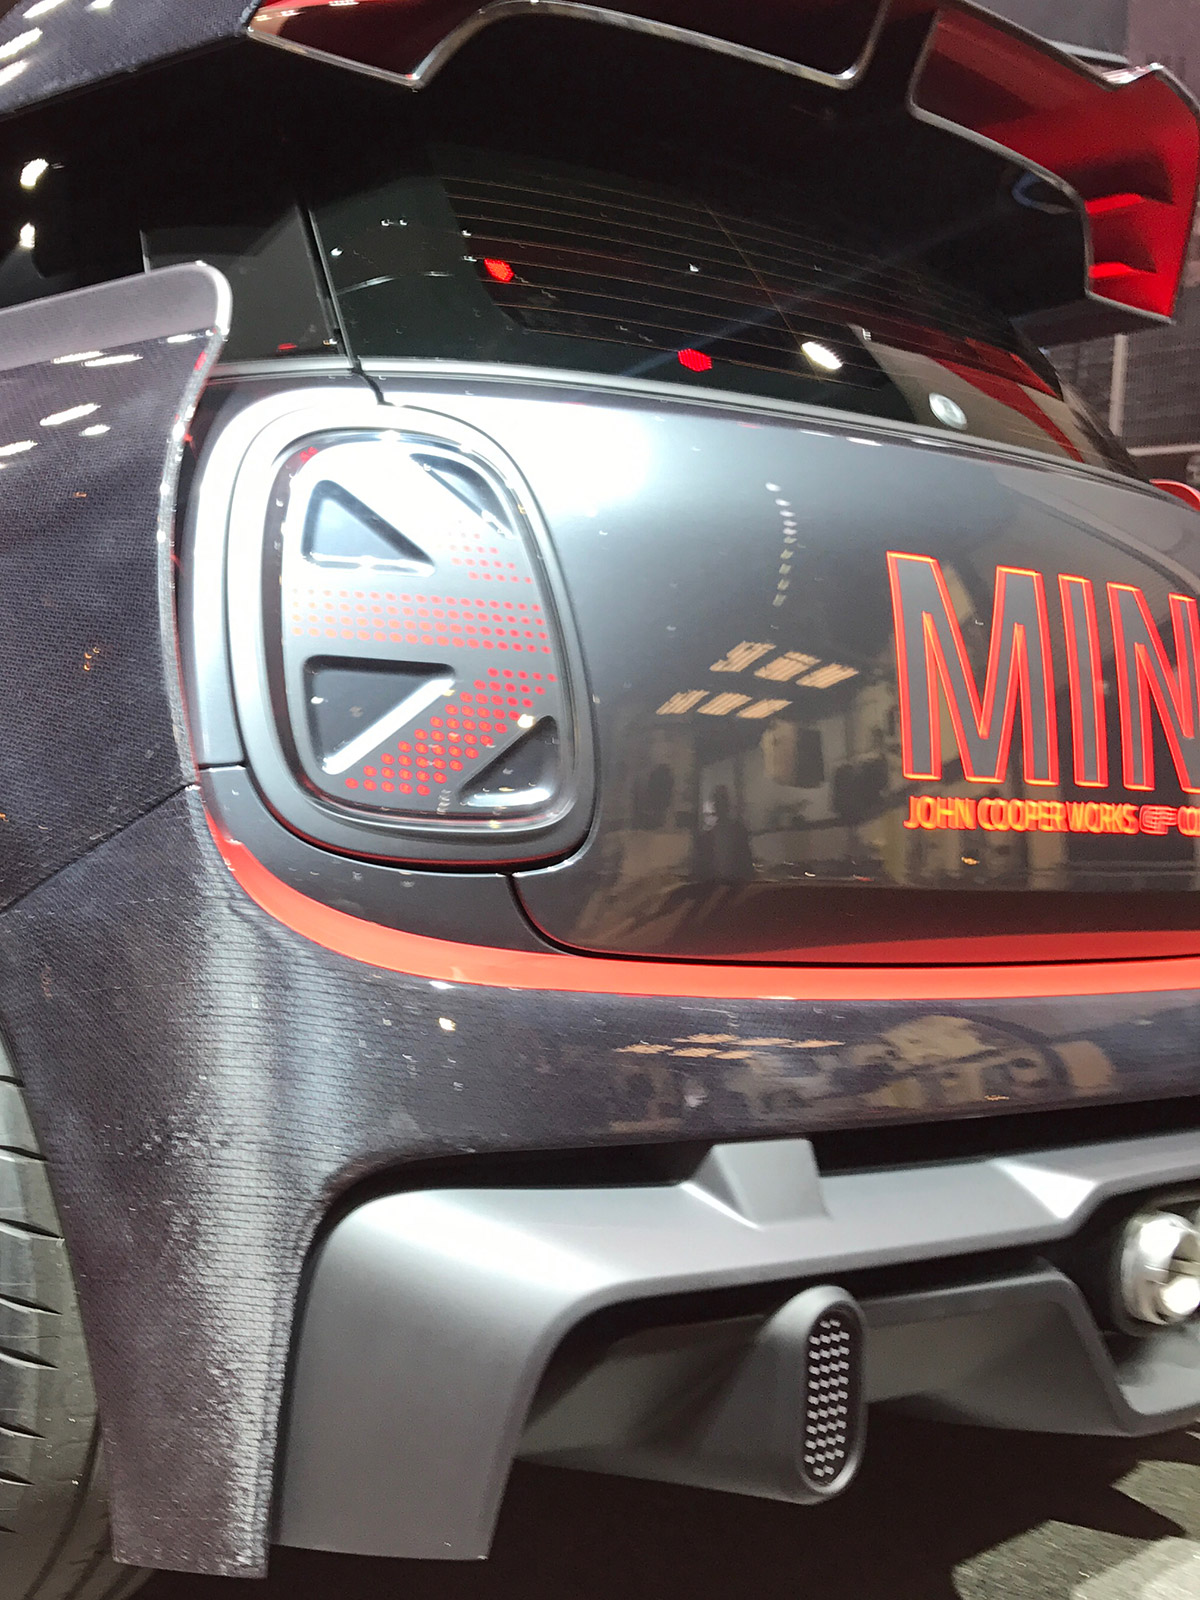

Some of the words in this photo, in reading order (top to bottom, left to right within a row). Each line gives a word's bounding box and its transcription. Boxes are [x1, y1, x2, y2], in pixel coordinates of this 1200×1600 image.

[903, 796, 977, 829] JOHN
[977, 797, 1067, 833] COOPER
[1066, 801, 1139, 834] WORKS
